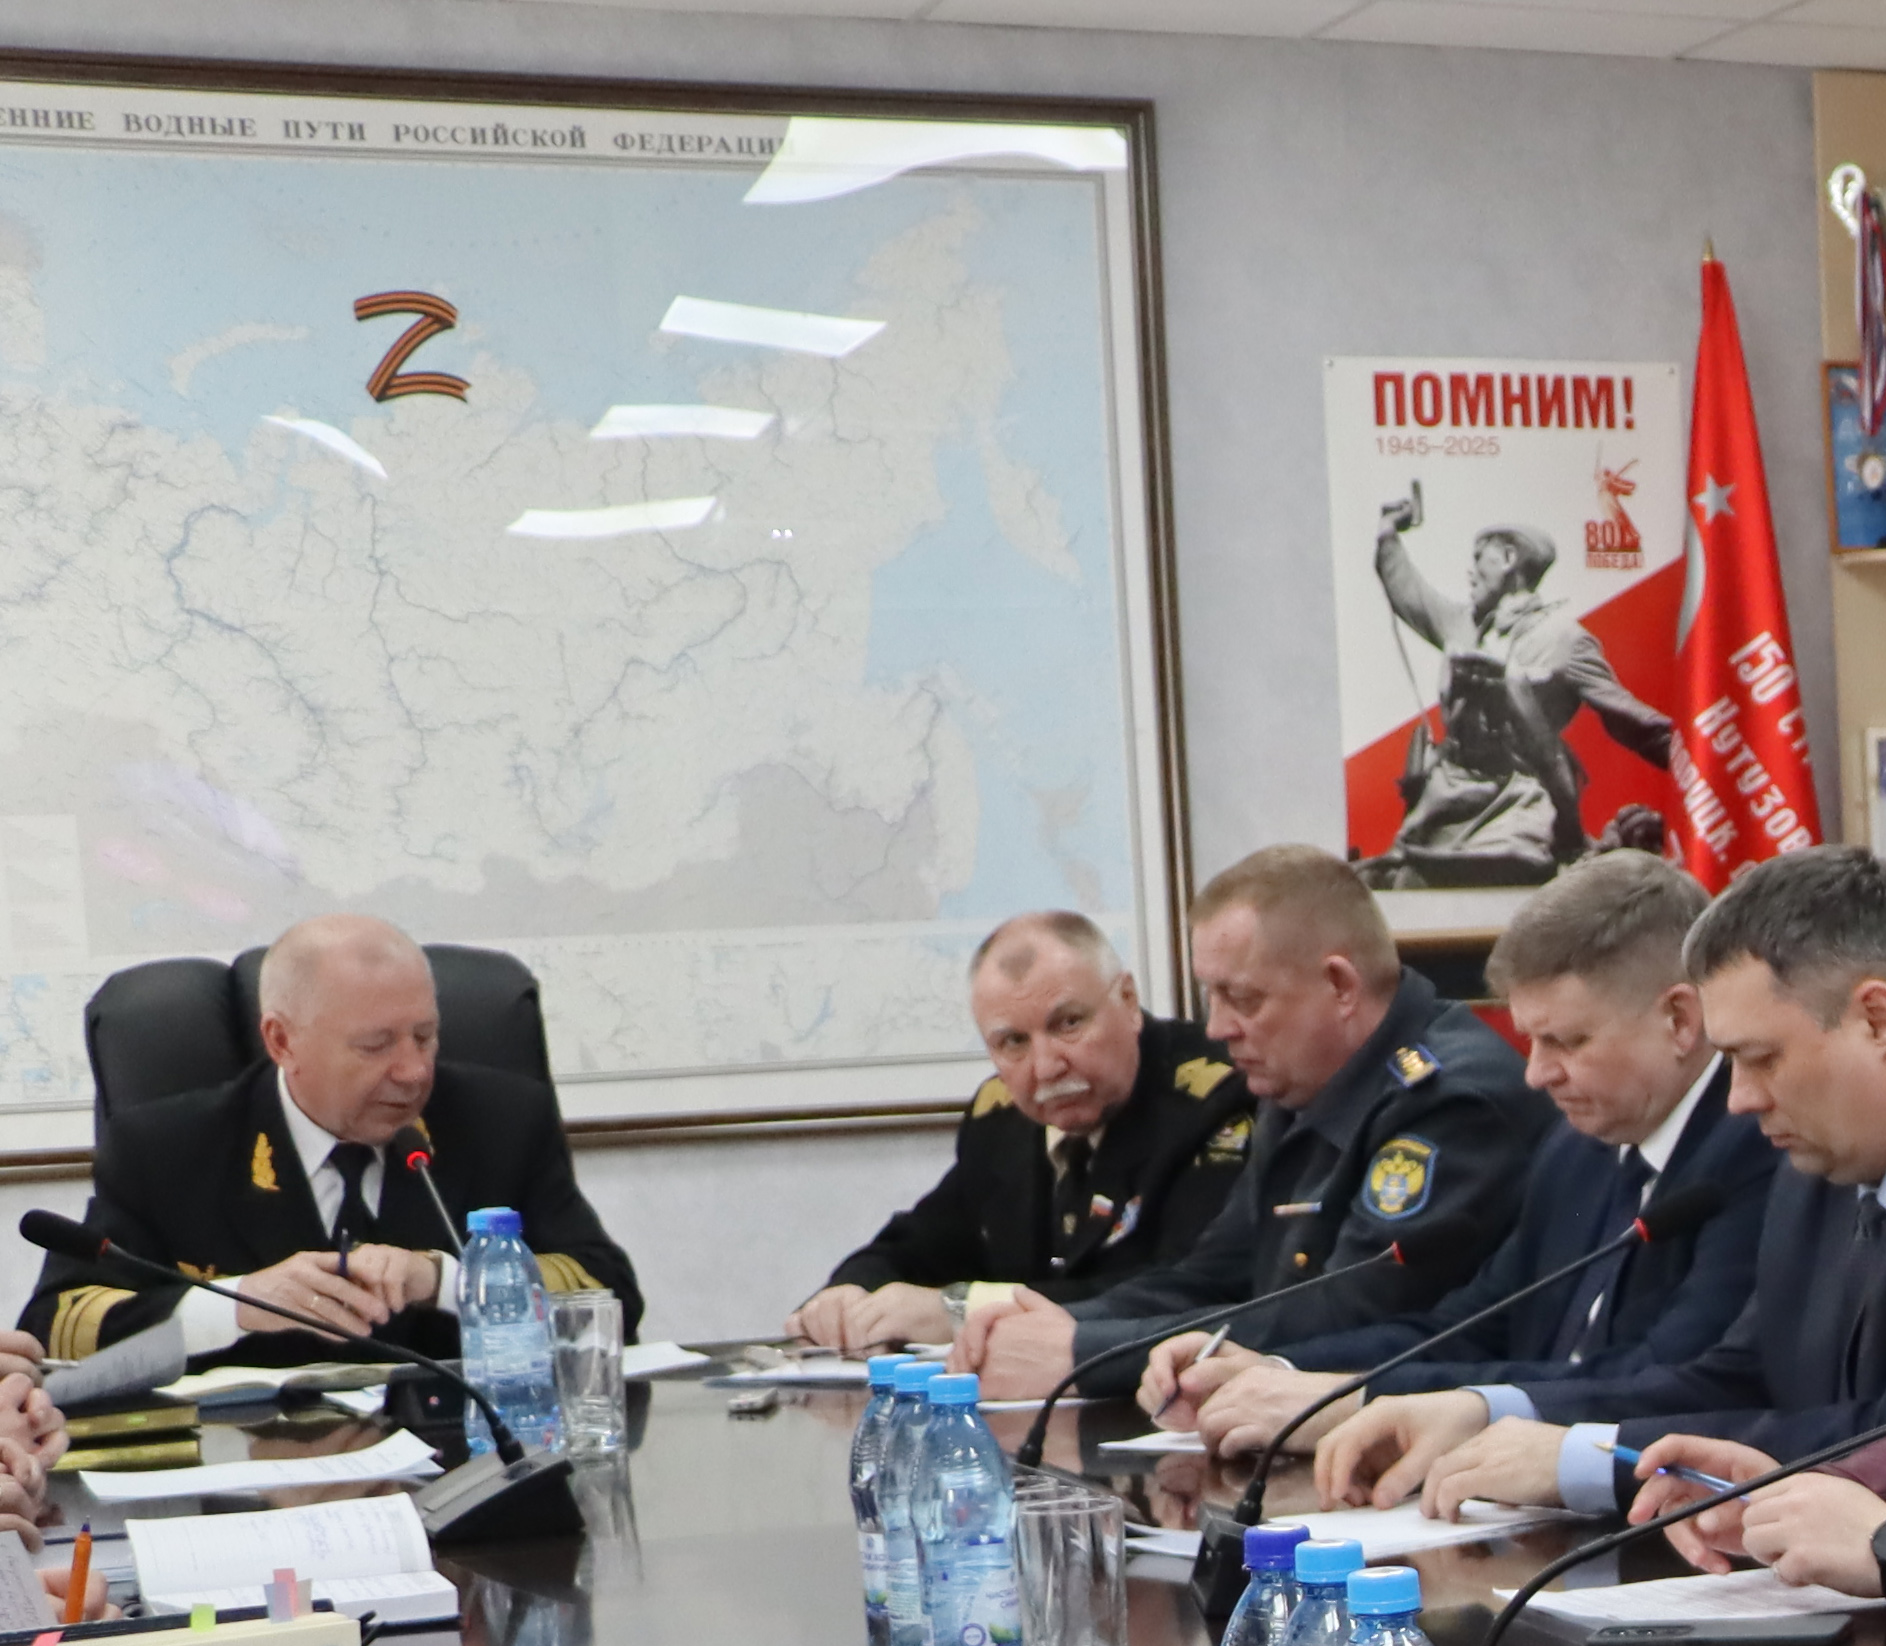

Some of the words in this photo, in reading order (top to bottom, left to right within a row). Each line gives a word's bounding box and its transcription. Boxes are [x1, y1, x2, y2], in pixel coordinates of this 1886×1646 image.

[123, 112, 258, 139] ВОДНЫЕ
[282, 119, 367, 142] ПУТИ
[392, 121, 588, 149] РОССИЙСКОЙ
[1372, 370, 1636, 431] ПОМНИМ!
[1728, 630, 1795, 704] 150
